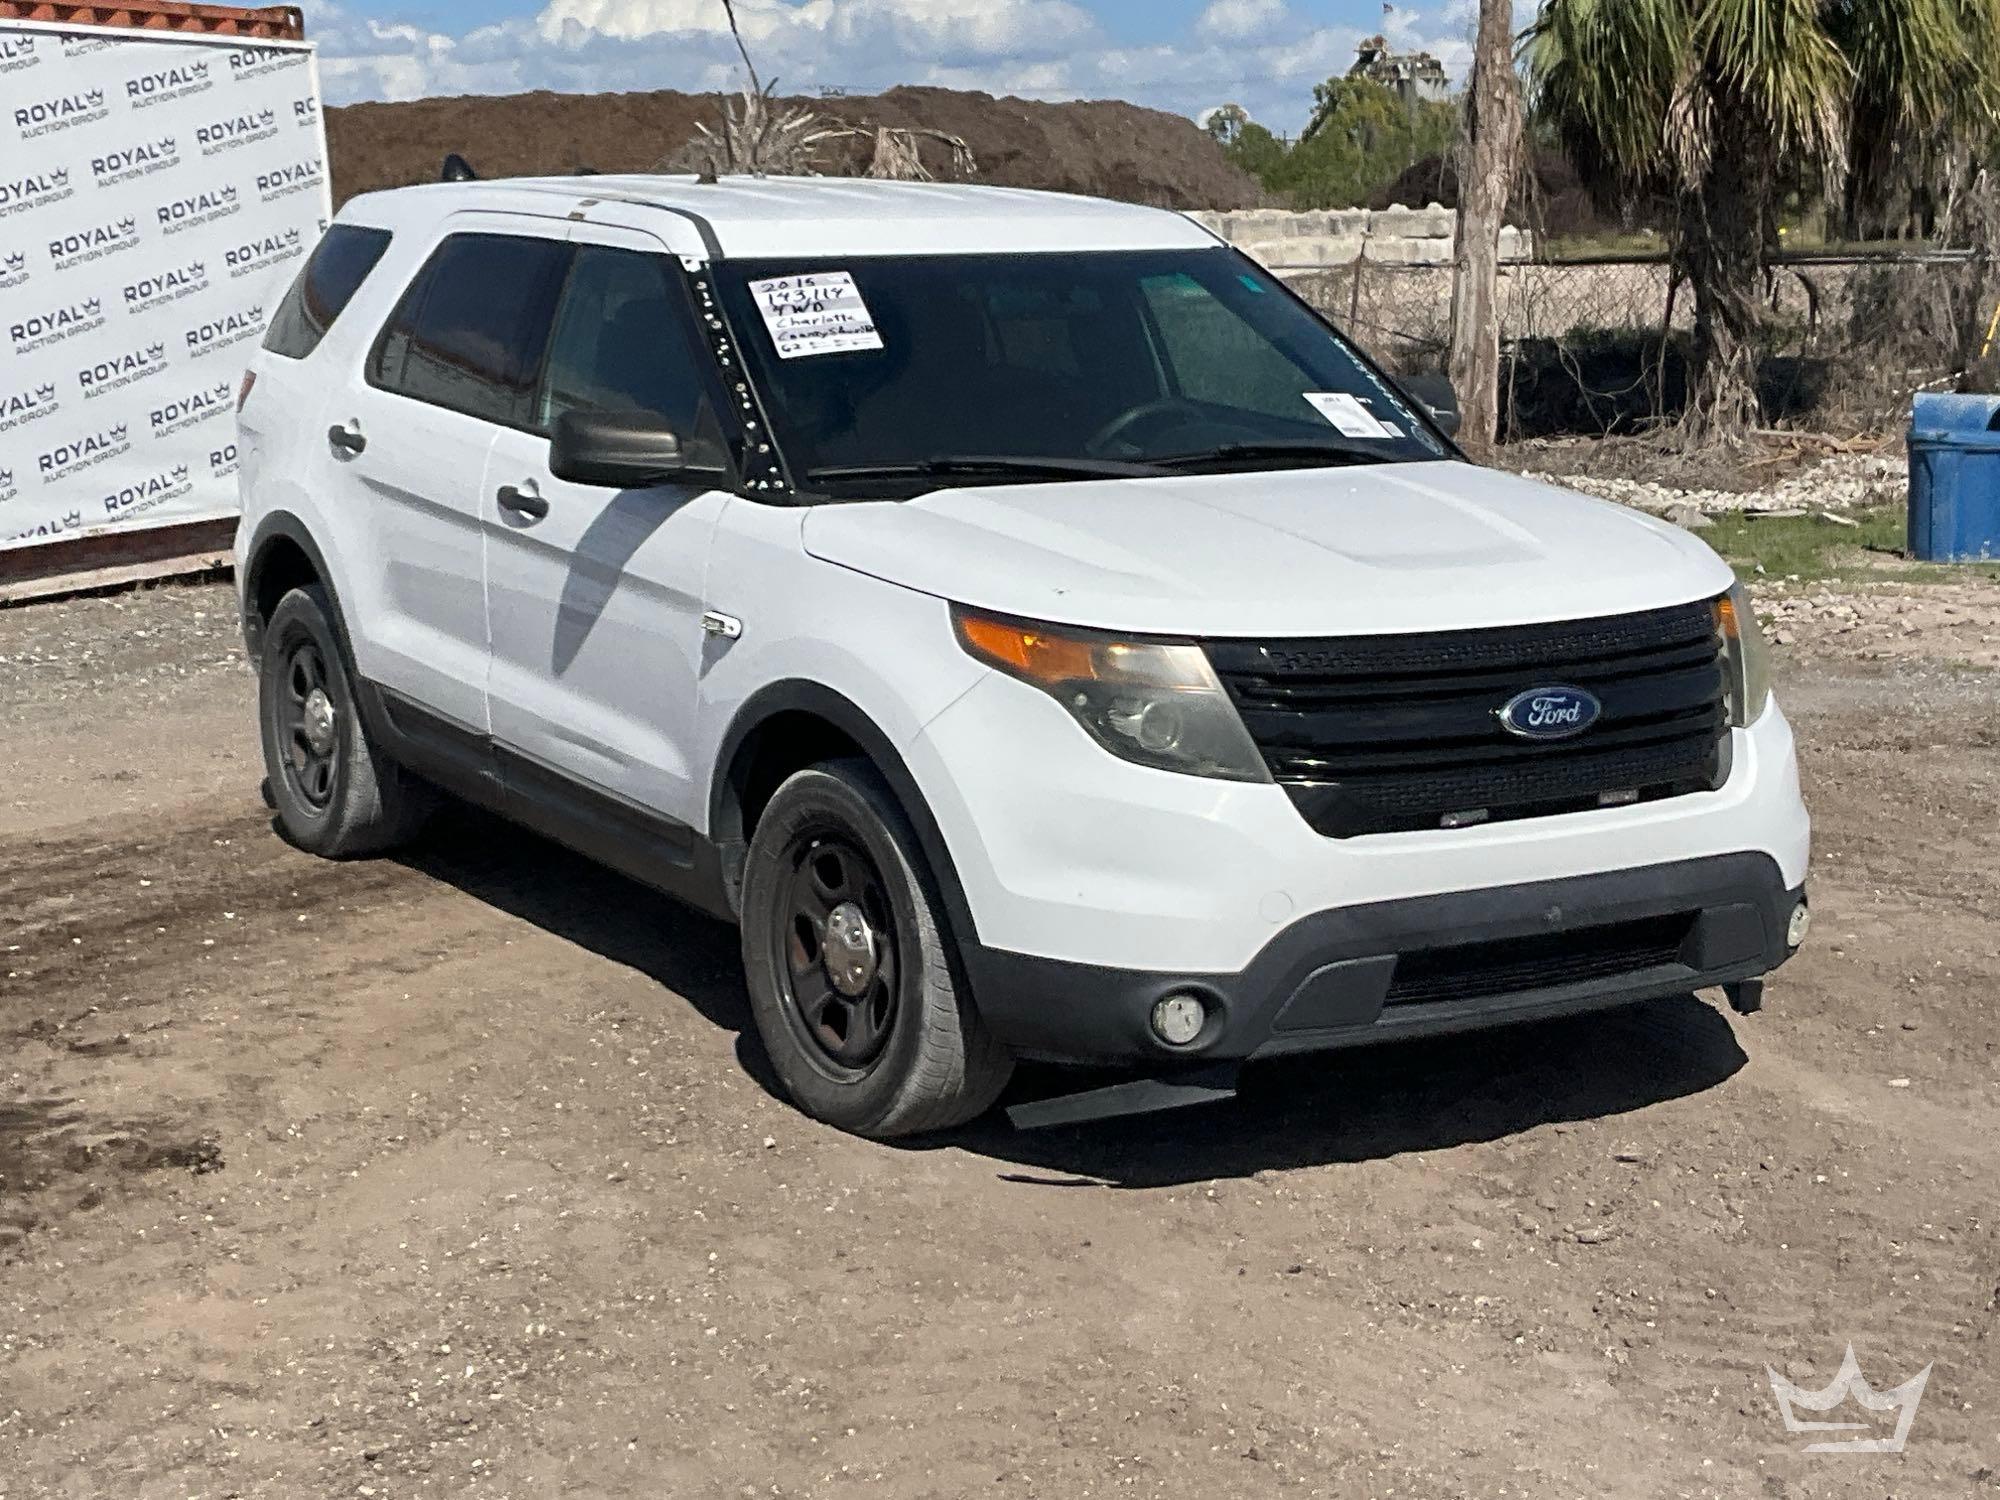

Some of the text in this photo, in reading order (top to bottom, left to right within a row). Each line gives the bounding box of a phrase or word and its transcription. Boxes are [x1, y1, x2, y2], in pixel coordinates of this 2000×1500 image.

[126, 67, 193, 97] ROYAL
[131, 80, 213, 110] AUCTION GROUP
[15, 95, 87, 127] ROYAL
[21, 108, 109, 140] AUCTION GROUP
[196, 115, 260, 145] ROYAL
[202, 127, 279, 156] AUCTION GROUP
[91, 143, 160, 176] ROYAL
[98, 156, 180, 188] AUCTION GROUP
[256, 162, 316, 191] ROYAL
[35, 188, 74, 207] GROUP
[157, 192, 222, 223] ROYAL
[162, 203, 241, 236] AUCTION GROUP
[49, 225, 119, 259] ROYAL
[54, 236, 141, 272] AUCTION GROUP
[225, 234, 286, 267] ROYAL
[230, 245, 303, 279] AUCTION GROUP
[123, 268, 190, 303] ROYAL
[128, 280, 209, 315] AUCTION GROUP
[760, 277, 815, 293] 2015
[10, 305, 84, 343] ROYAL
[16, 317, 106, 356] AUCTION GROUP
[186, 312, 249, 348] ROYAL
[190, 323, 267, 359] AUCTION GROUP
[79, 350, 148, 388] ROYAL
[84, 361, 168, 400] AUCTION GROUP
[19, 402, 60, 425] GROUP
[150, 390, 216, 428] ROYAL
[154, 401, 235, 440] AUCTION GROUP
[38, 432, 111, 473] ROYAL
[43, 442, 132, 485] AUCTION GROUP
[104, 474, 173, 513] ROYAL
[157, 482, 193, 505] GROUP
[1528, 696, 1581, 726] Ford
